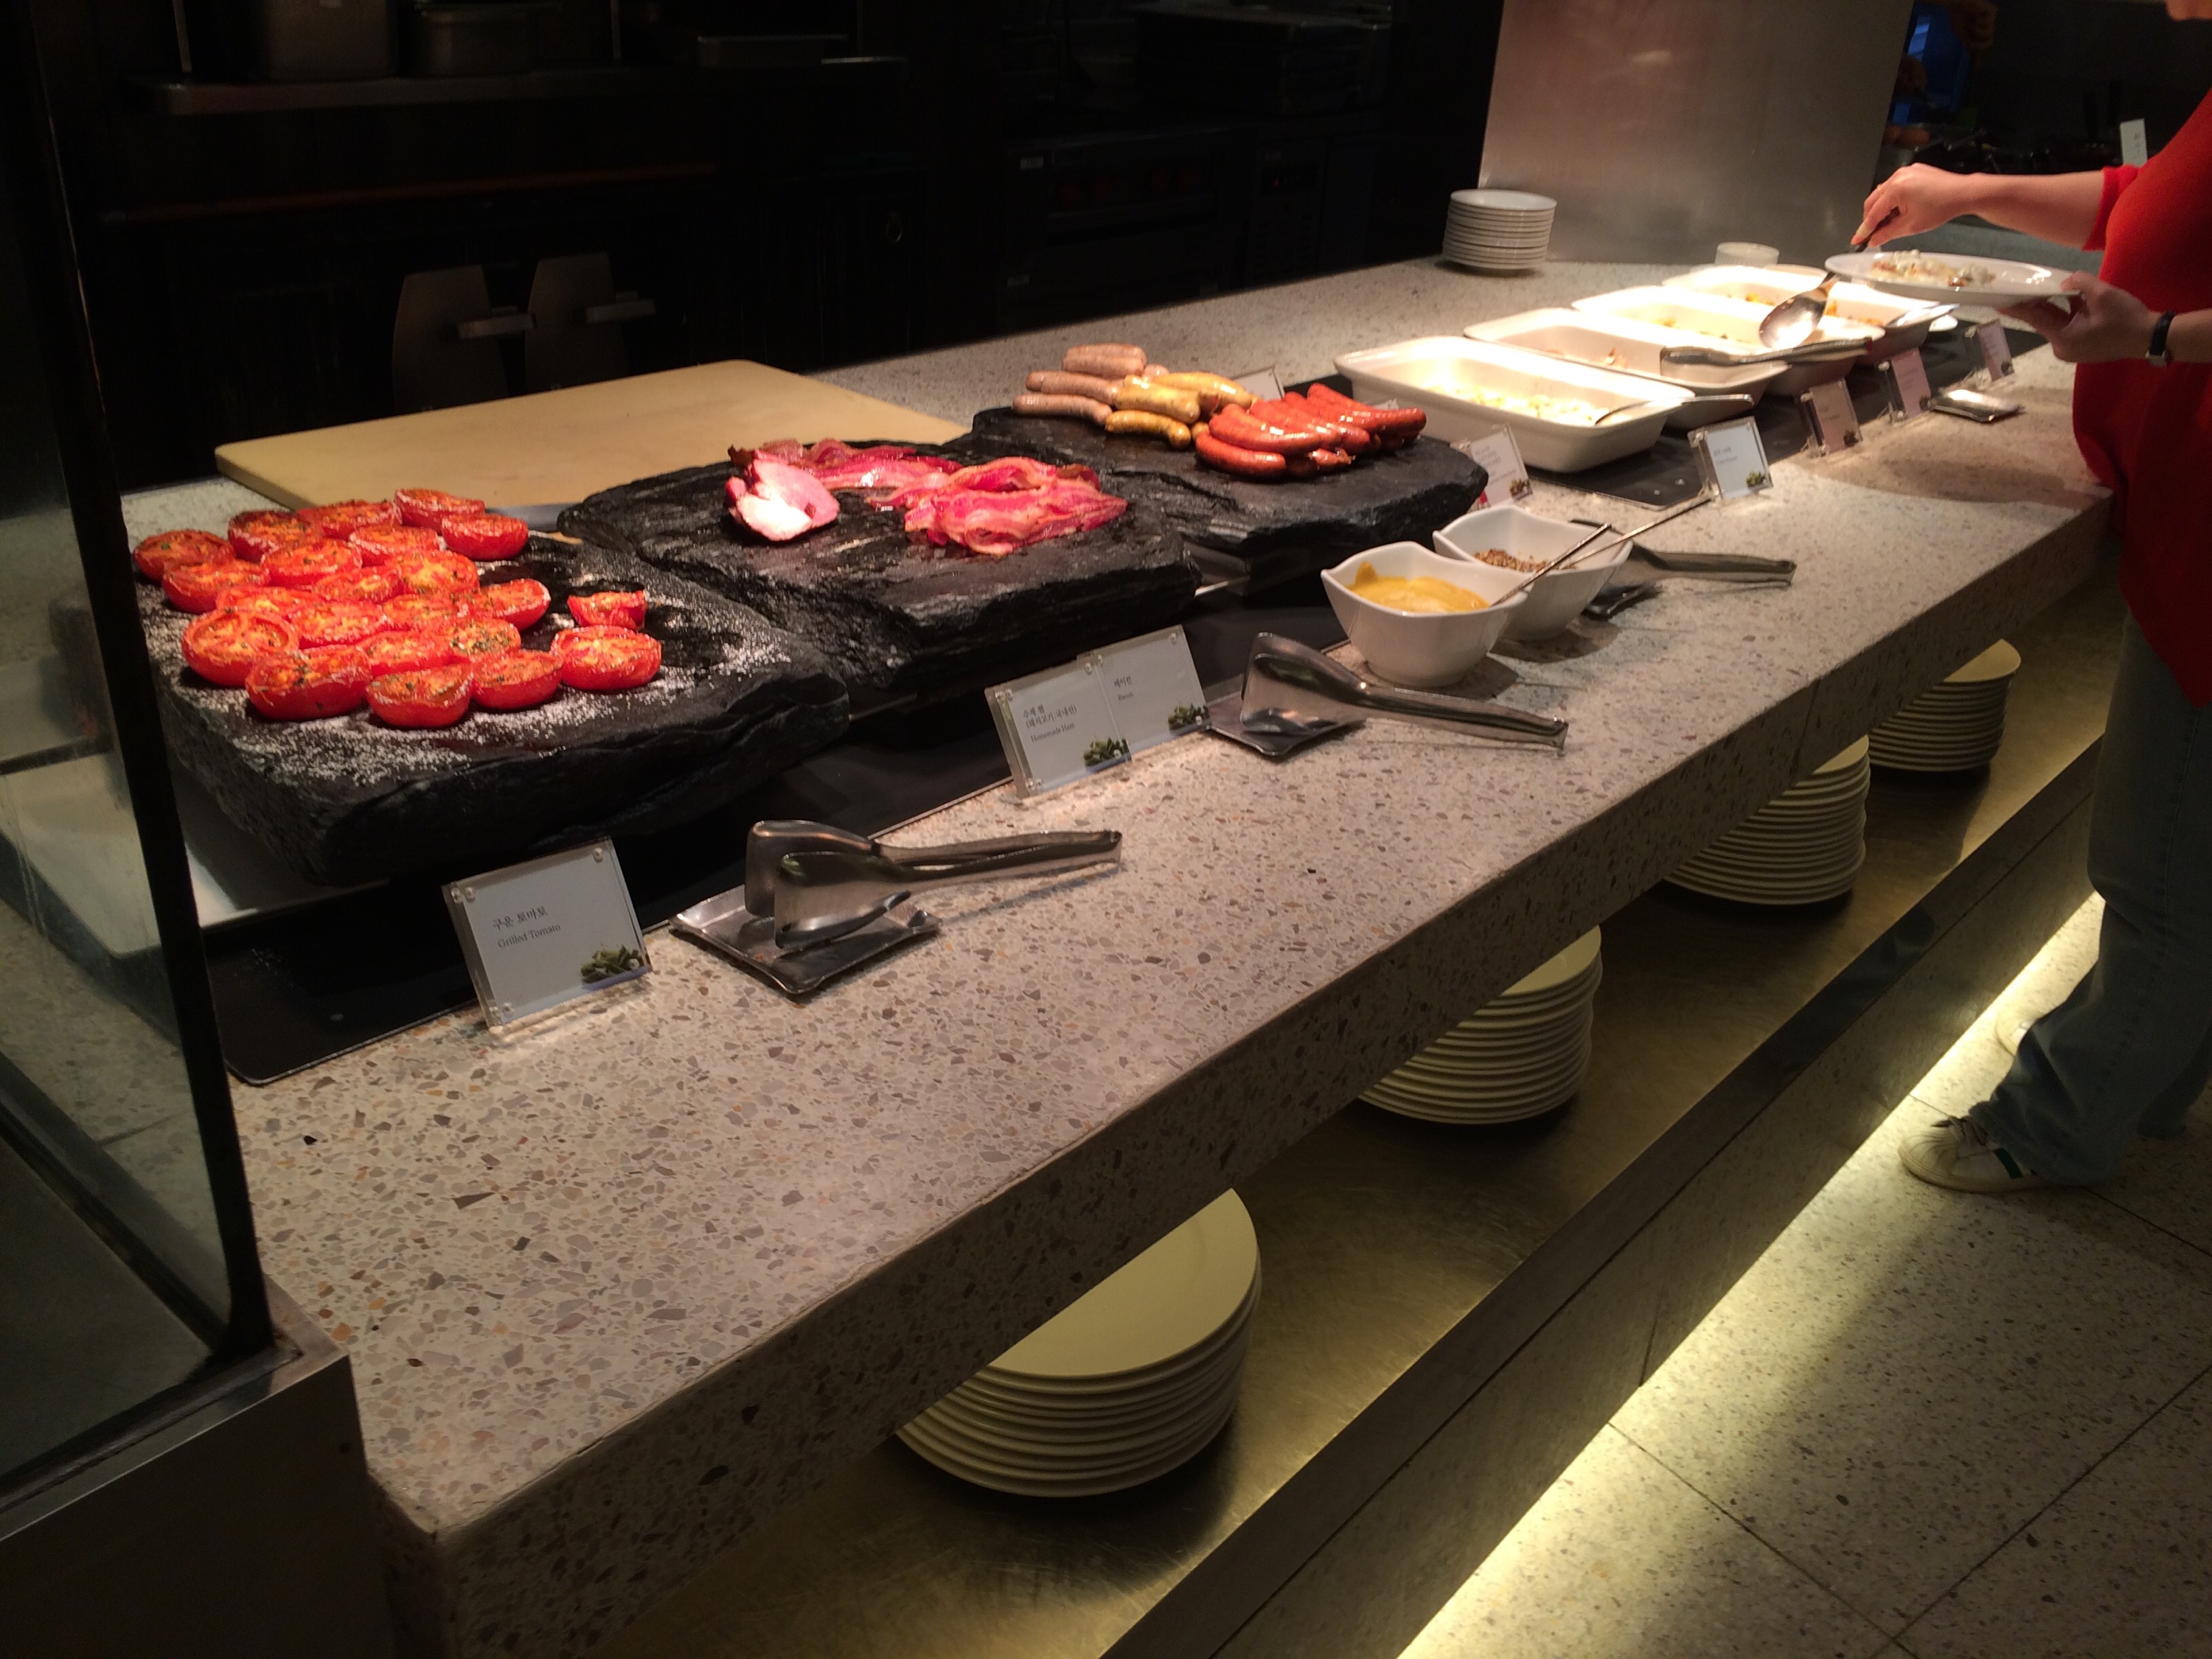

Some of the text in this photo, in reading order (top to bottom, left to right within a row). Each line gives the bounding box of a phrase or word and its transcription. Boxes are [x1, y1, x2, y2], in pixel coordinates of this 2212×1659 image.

[492, 905, 548, 931] 구운 토마토
[498, 924, 560, 948] Grilled Tomato
